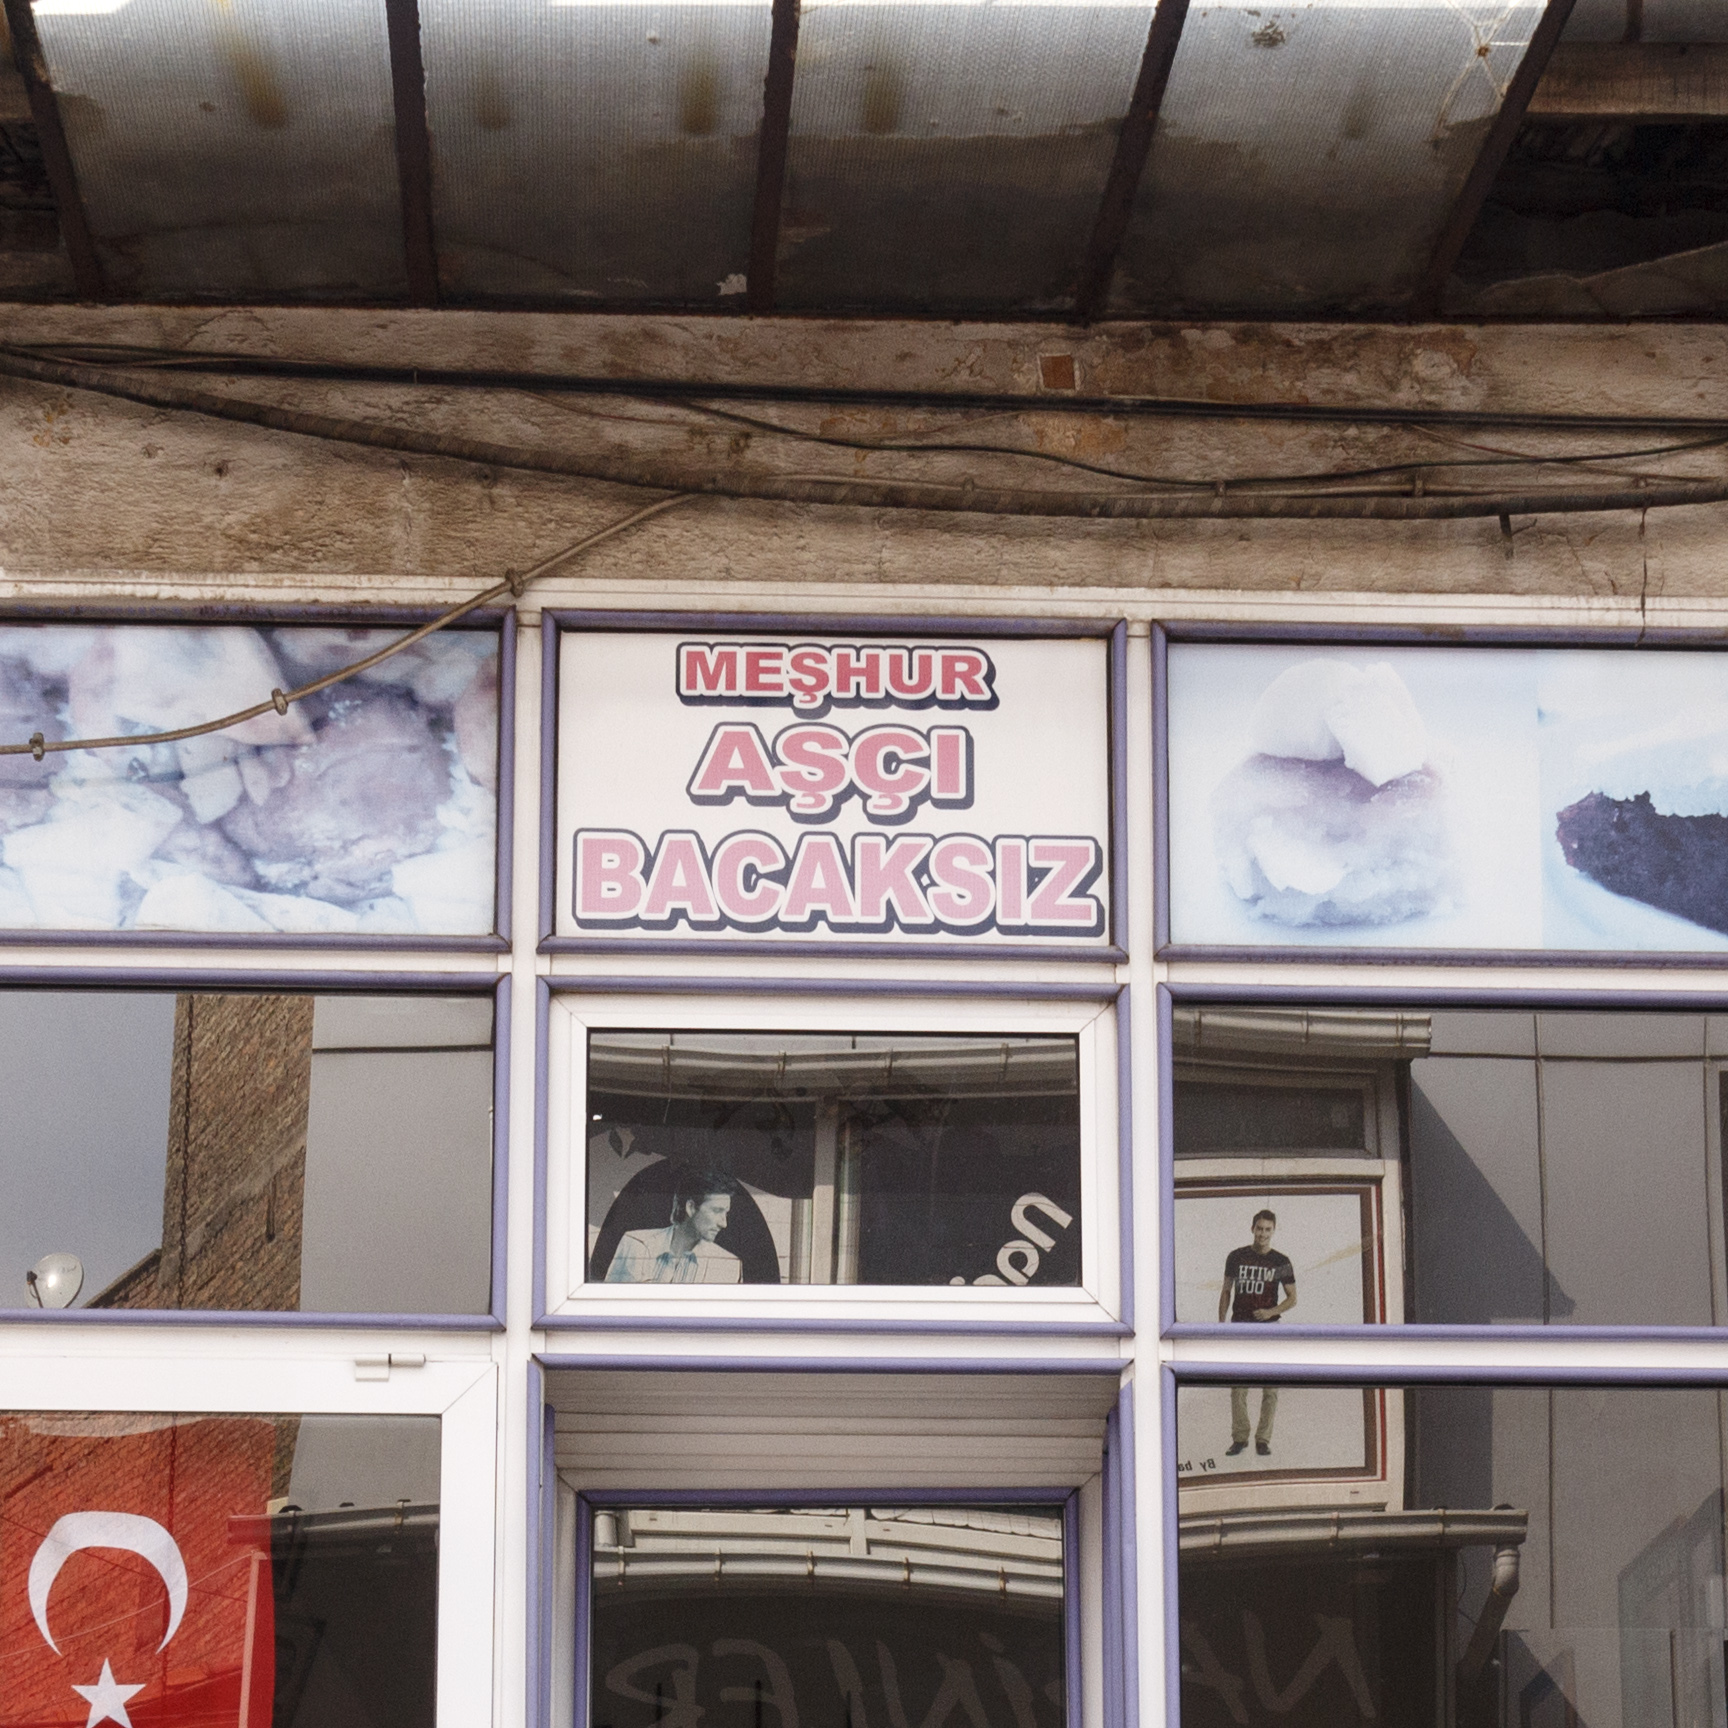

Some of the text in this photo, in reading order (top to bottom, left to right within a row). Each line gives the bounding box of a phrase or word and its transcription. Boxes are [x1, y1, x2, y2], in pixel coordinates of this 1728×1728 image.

[677, 644, 996, 714] MEŞHUR
[688, 724, 971, 821] AŞÇI
[574, 830, 1103, 933] BACAKSIZ
